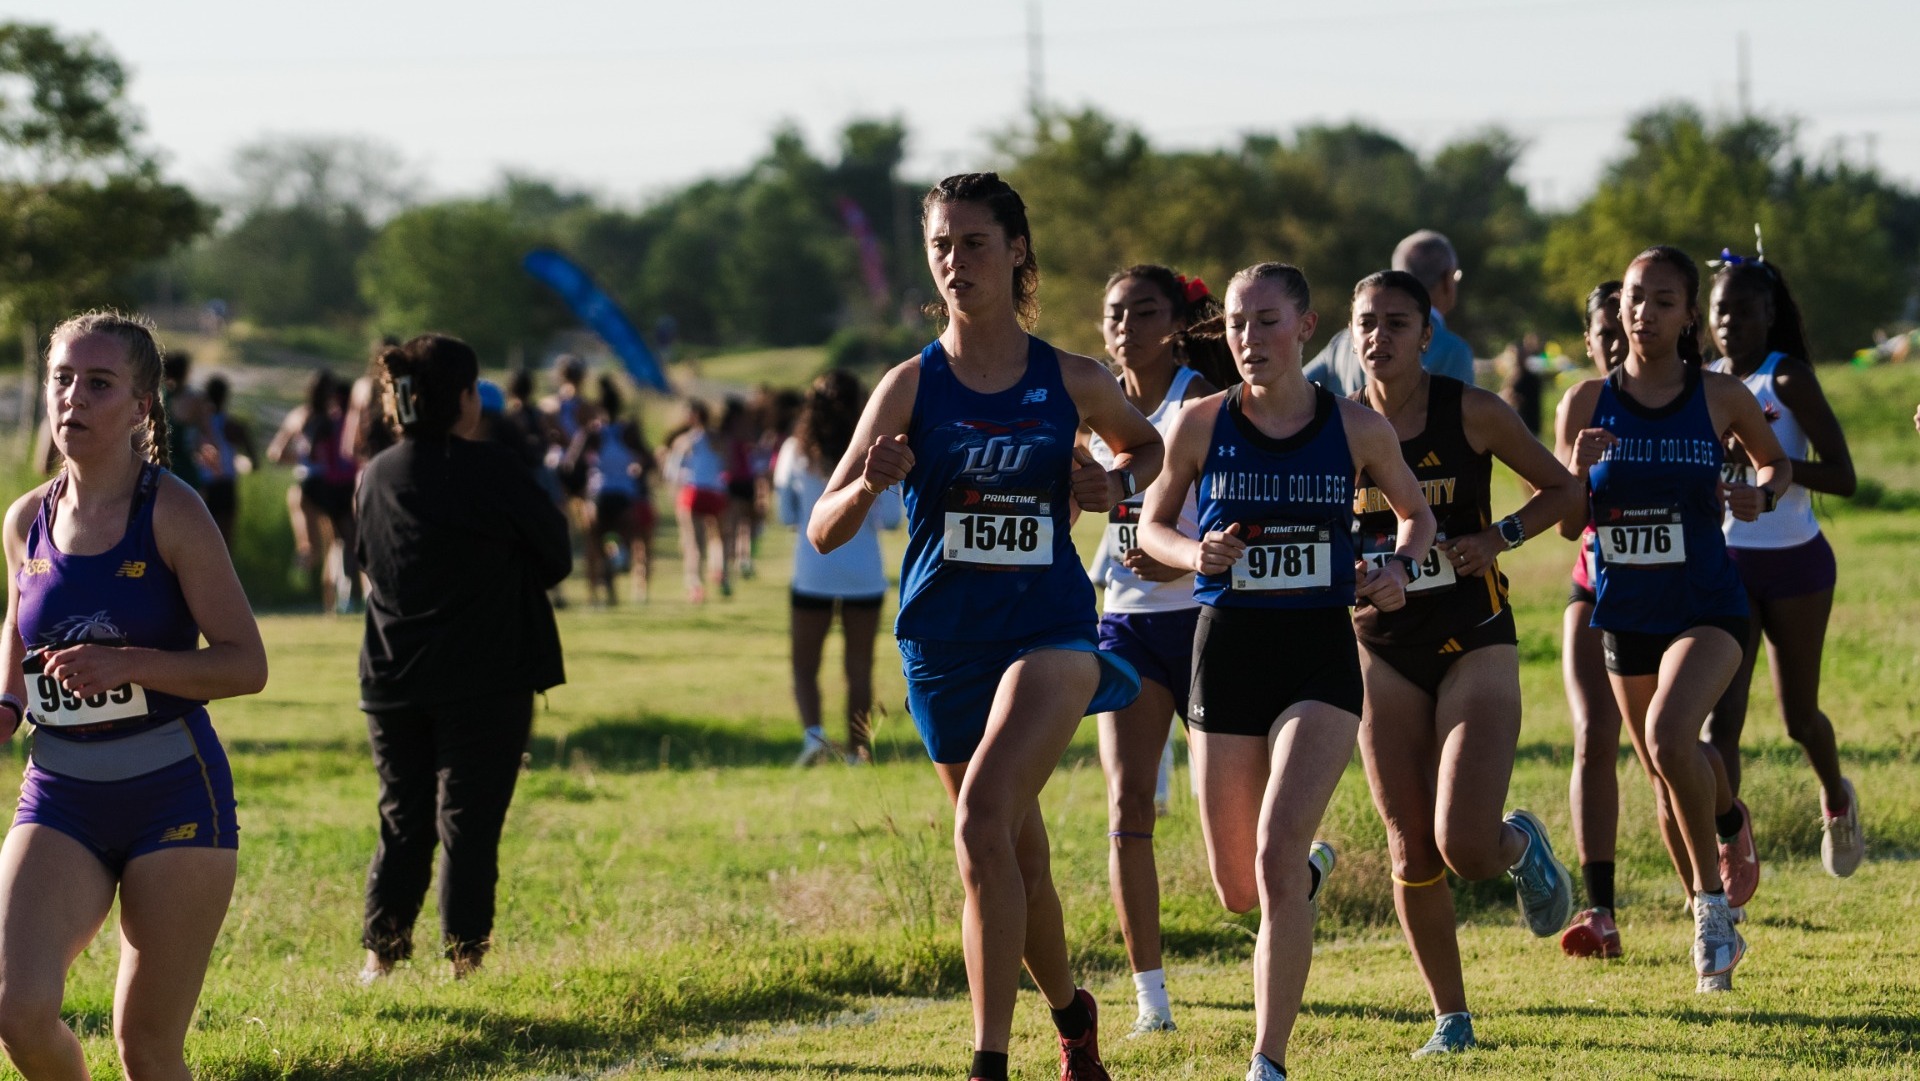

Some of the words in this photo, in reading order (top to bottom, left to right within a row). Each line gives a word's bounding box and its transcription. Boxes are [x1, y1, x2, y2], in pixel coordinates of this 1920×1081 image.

[1660, 439, 1715, 466] COLLEGE
[982, 493, 1038, 504] PRIMETIME
[1210, 470, 1280, 502] AMARILLO
[1288, 473, 1346, 504] COLLEGE
[1623, 507, 1669, 517] PRIMETIME
[959, 515, 1039, 552] 1548
[1263, 524, 1317, 534] PRIMETIME
[1611, 525, 1672, 554] 9776
[1248, 544, 1316, 579] 9781
